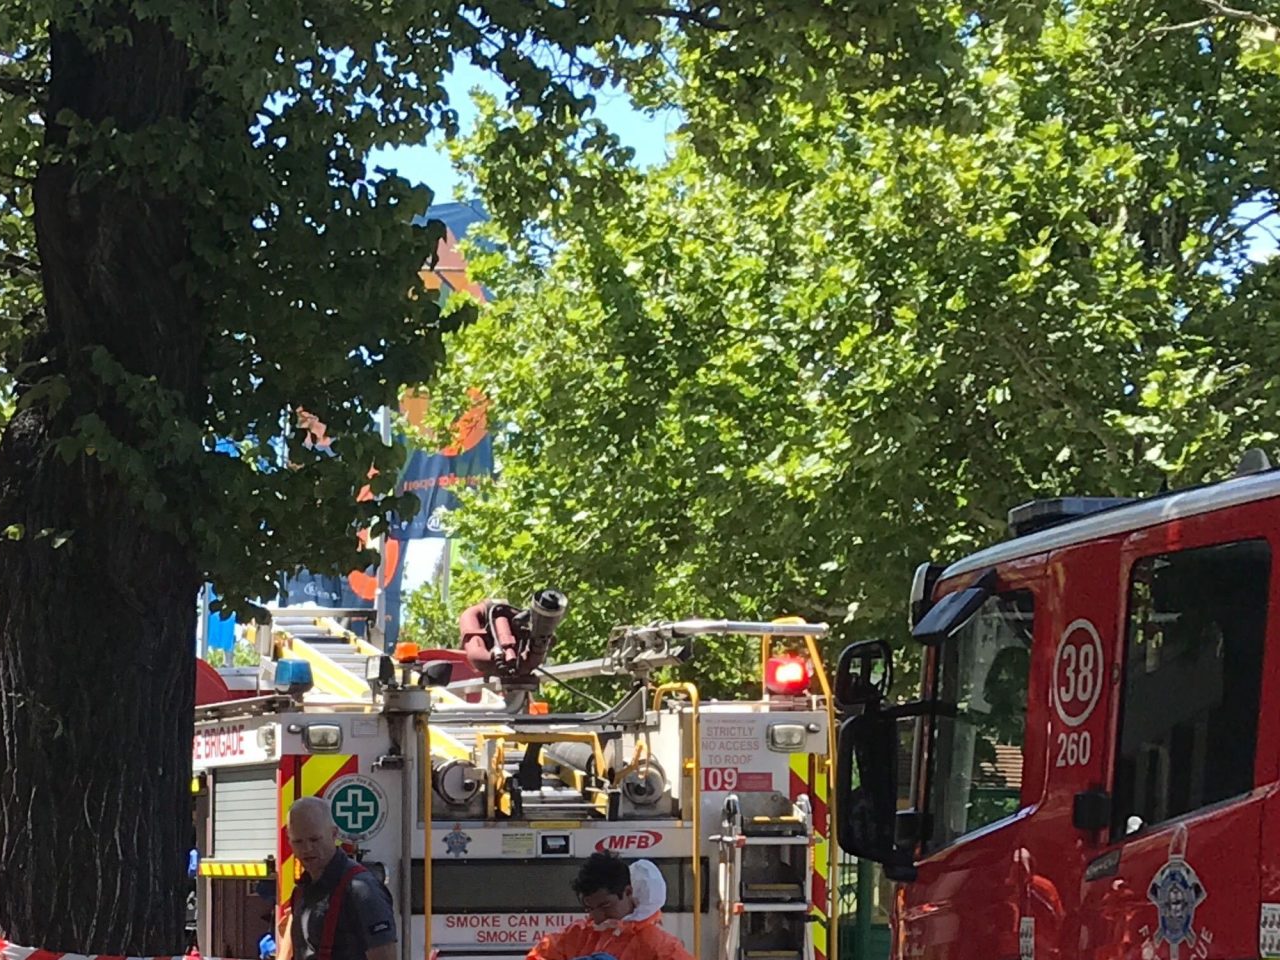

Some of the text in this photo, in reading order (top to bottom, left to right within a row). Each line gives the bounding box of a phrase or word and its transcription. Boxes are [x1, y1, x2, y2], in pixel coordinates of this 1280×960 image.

[1060, 644, 1094, 702] 38
[706, 726, 754, 737] STRICTLY
[205, 724, 245, 759] BRIGADE
[702, 740, 760, 751] NO ACCESS
[1055, 731, 1091, 767] 260
[708, 755, 753, 765] TO ROOF
[608, 834, 650, 850] MFB
[446, 915, 501, 928] SMOKE
[508, 915, 539, 928] CAN
[477, 931, 527, 943] SMOKE
